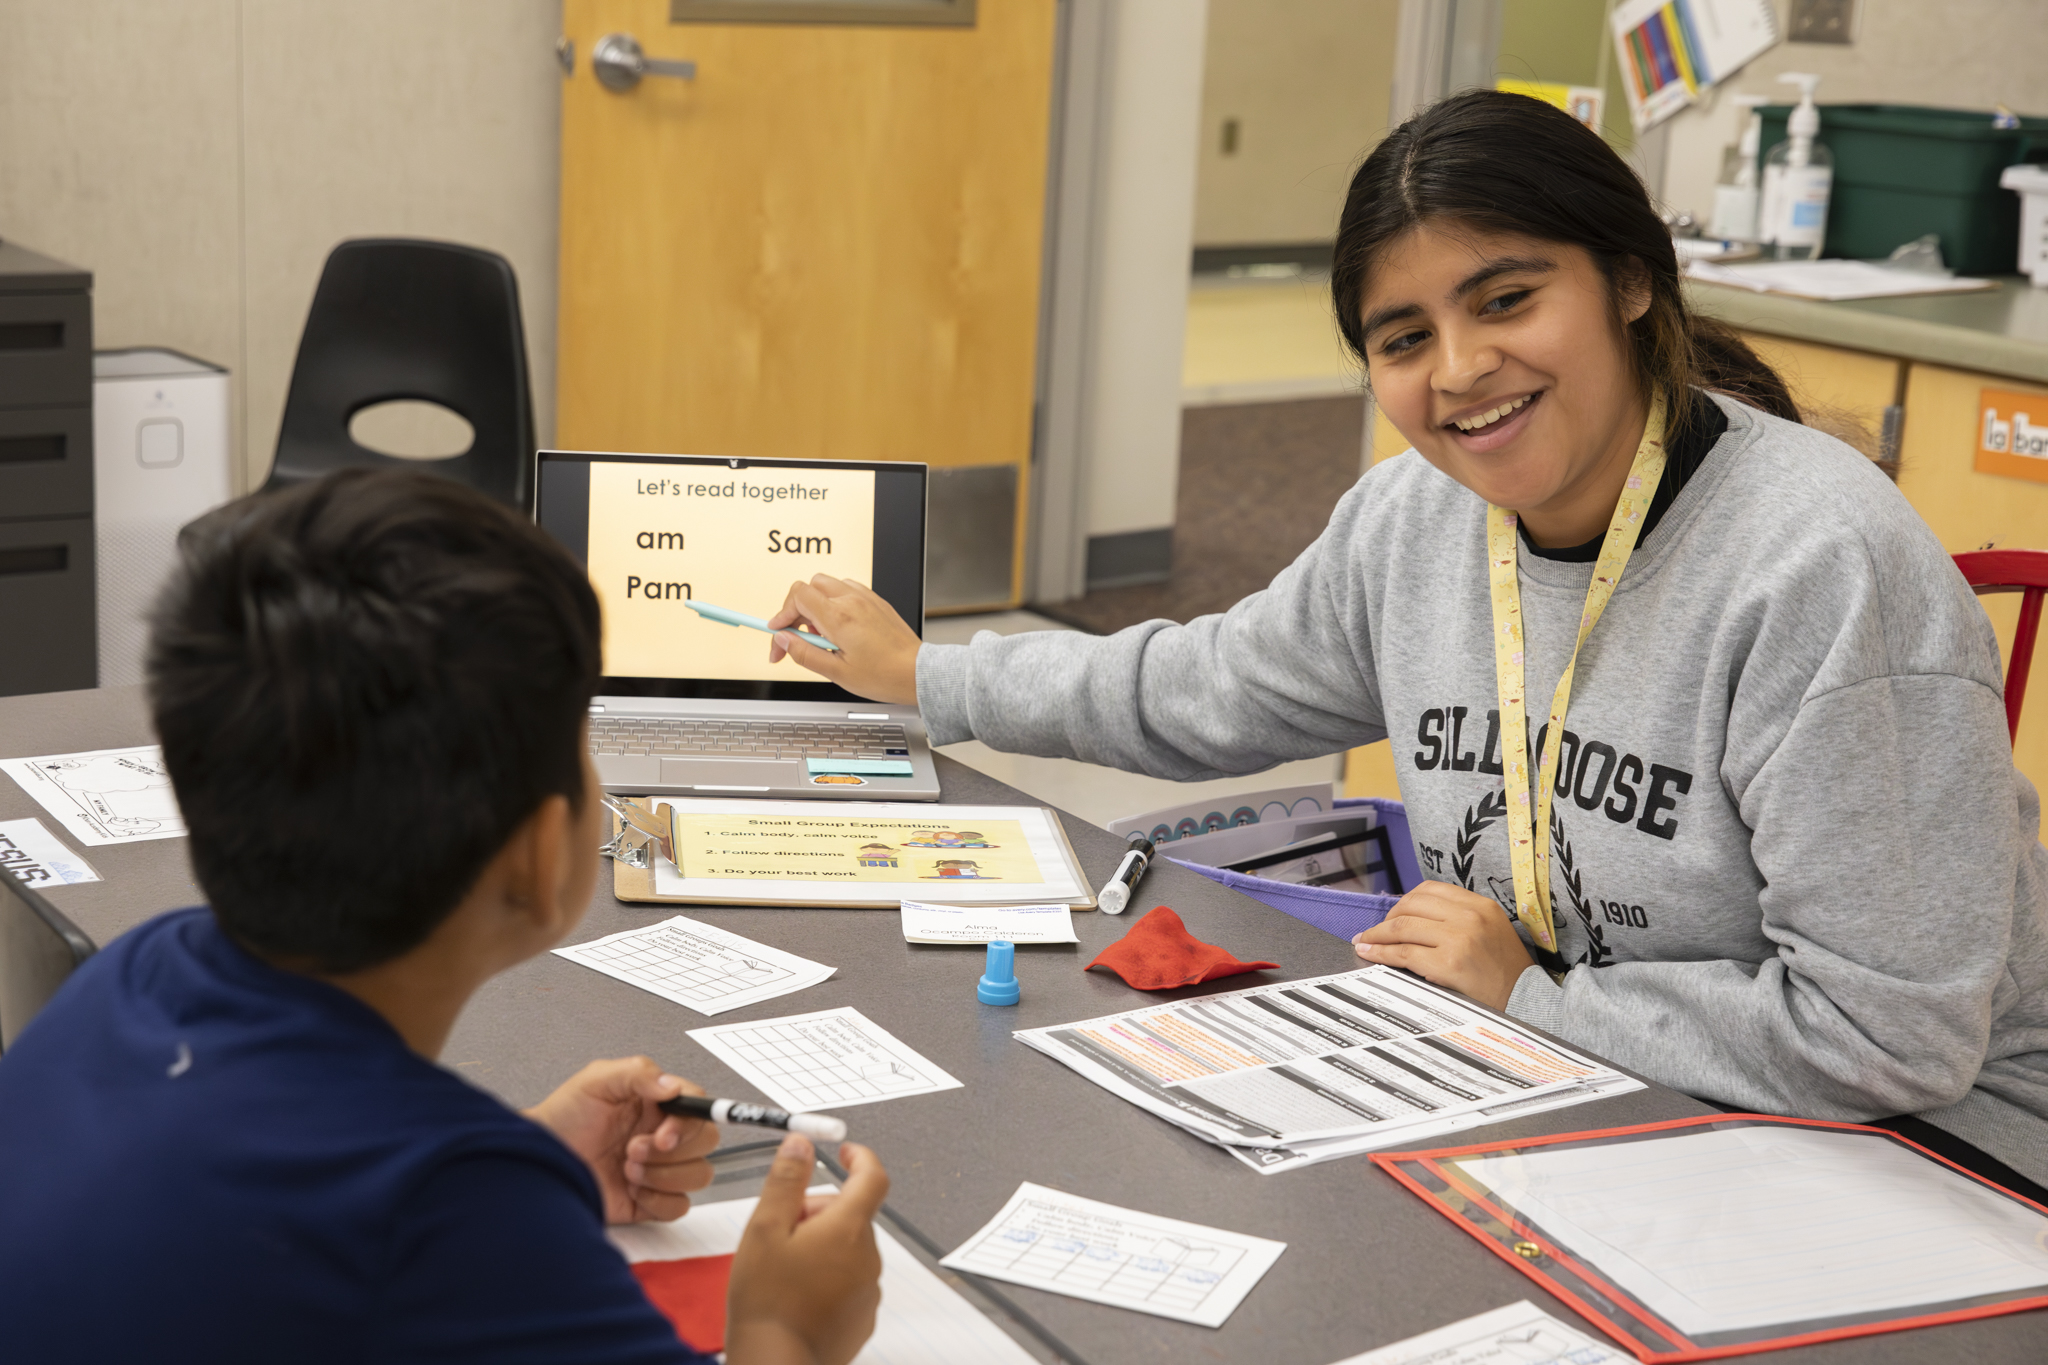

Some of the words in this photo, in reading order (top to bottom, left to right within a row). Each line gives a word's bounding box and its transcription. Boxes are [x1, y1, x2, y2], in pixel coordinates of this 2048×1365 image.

[638, 479, 680, 496] Let's
[688, 481, 734, 498] read
[742, 482, 828, 502] together
[636, 531, 684, 550] am
[768, 530, 832, 554] Sam
[626, 576, 692, 600] Pam
[1600, 900, 1648, 928] 1910
